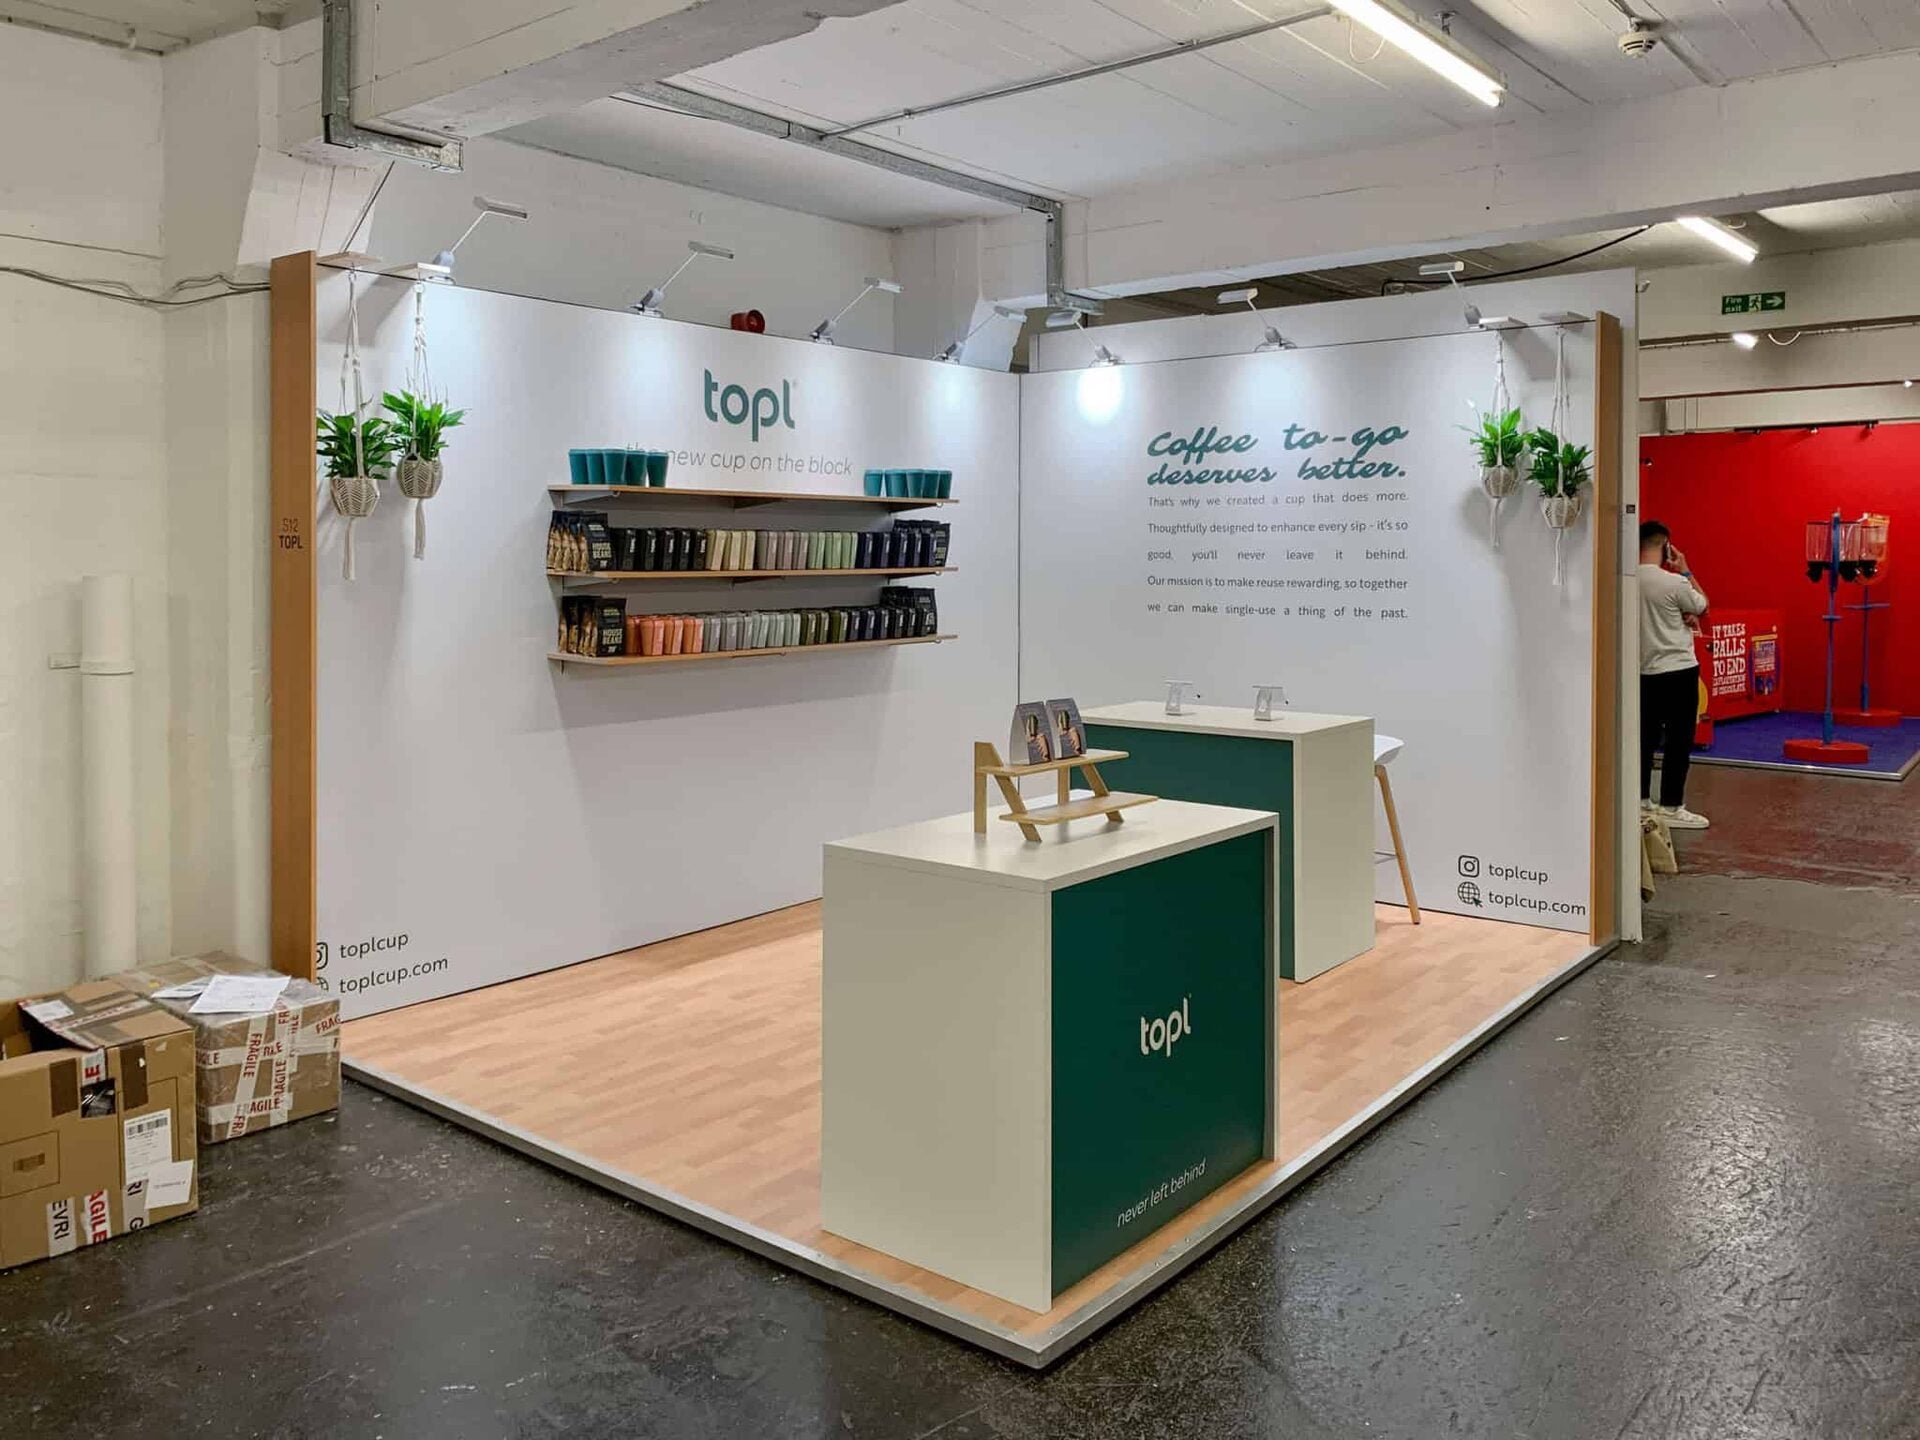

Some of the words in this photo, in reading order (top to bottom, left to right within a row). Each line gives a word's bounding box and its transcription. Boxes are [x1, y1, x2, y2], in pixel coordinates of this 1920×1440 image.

[704, 368, 796, 442] topl
[1147, 426, 1259, 465] Coffee
[1283, 423, 1409, 460] to-go
[667, 450, 706, 466] new
[710, 453, 746, 473] cup
[750, 456, 772, 471] on
[777, 455, 804, 473] the
[808, 455, 853, 476] block
[1147, 463, 1278, 485] deserves
[1297, 457, 1406, 480] better.
[1179, 497, 1200, 509] why
[1206, 498, 1221, 506] we
[1226, 495, 1265, 505] created
[1285, 495, 1305, 507] cup
[1312, 493, 1334, 503] that
[1341, 491, 1369, 503] does
[1148, 523, 1207, 536] Thoughtfully
[1209, 523, 1254, 535] designed
[1257, 523, 1268, 533] to
[1270, 522, 1315, 533] enhance
[1318, 523, 1347, 533] every
[1350, 521, 1366, 533] sip
[1377, 519, 1393, 531] it's
[1395, 521, 1408, 531] so
[279, 535, 304, 550] TOPL
[1237, 551, 1265, 560] never
[1286, 549, 1314, 560] leave
[1335, 549, 1343, 560] it
[1147, 575, 1165, 586] Our
[1167, 577, 1204, 586] mission
[1205, 577, 1213, 587] is
[1215, 577, 1225, 587] to
[1227, 577, 1255, 588] make
[1257, 579, 1285, 588] reuse
[1344, 581, 1357, 589] so
[1359, 578, 1408, 591] together
[1147, 603, 1161, 613] we
[1167, 603, 1185, 613] can
[1191, 603, 1218, 613] make
[1225, 603, 1276, 617] single-use
[1298, 606, 1326, 619] thing
[1334, 606, 1345, 617] of
[1353, 606, 1372, 617] the
[1713, 638, 1746, 658] BALLS
[1713, 661, 1726, 677] TO
[1727, 657, 1746, 675] END
[1488, 864, 1548, 885] toplcup
[1488, 891, 1586, 916] toplcup.com
[340, 934, 409, 958] toplcup
[339, 958, 448, 993] toplcup.com
[1140, 997, 1191, 1058] topl
[243, 1033, 263, 1078] FRAGILE
[1117, 1197, 1148, 1228] never
[1150, 1183, 1168, 1207] left
[1170, 1157, 1206, 1193] behind
[52, 1200, 70, 1240] EVRI
